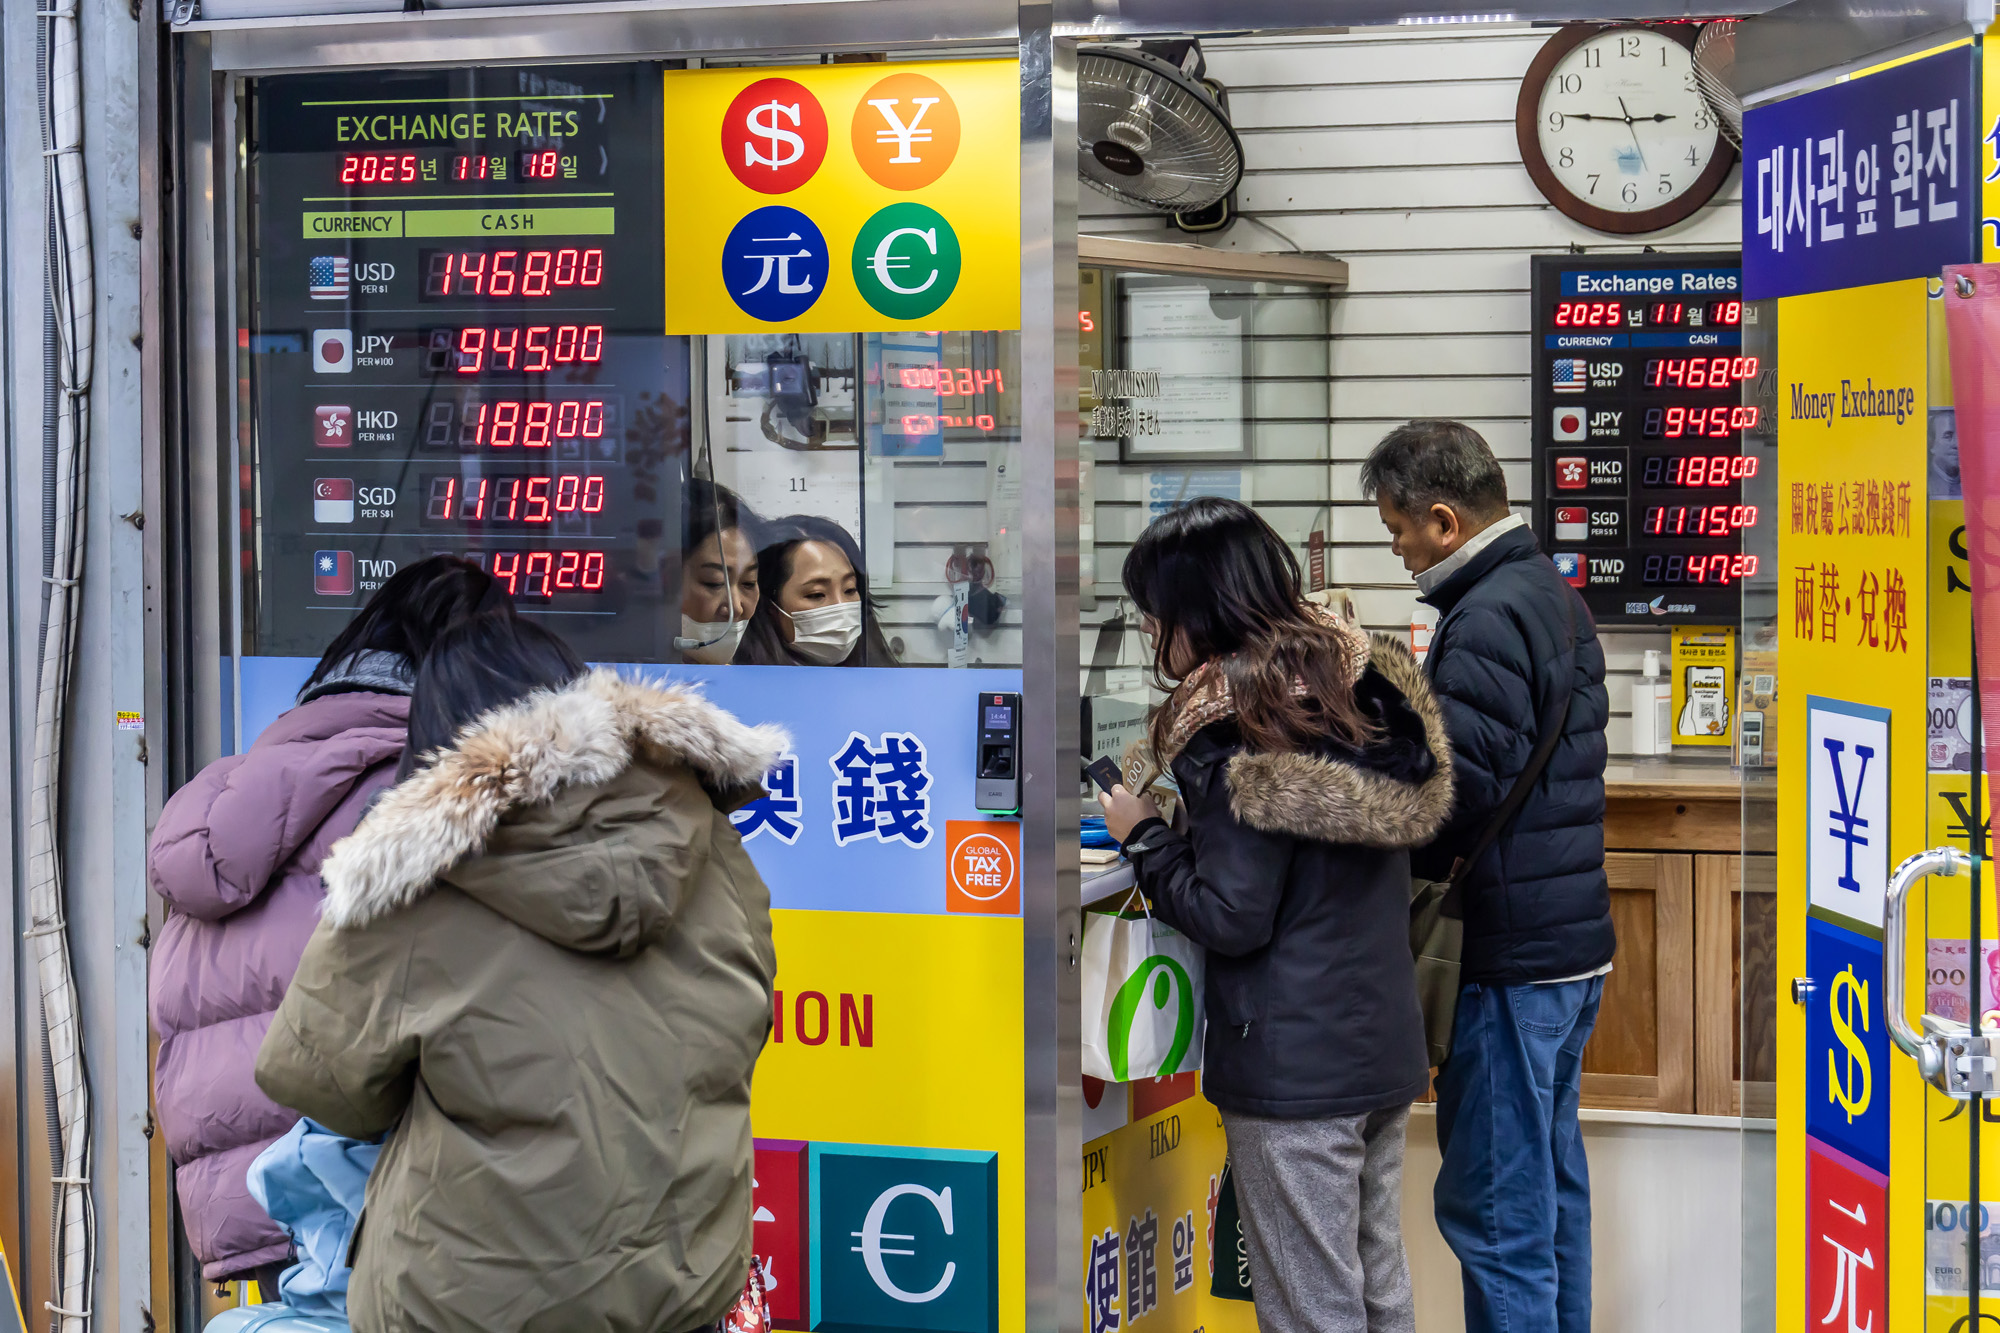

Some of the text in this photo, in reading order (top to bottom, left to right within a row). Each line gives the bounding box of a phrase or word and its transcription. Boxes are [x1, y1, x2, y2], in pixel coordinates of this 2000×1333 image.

[1584, 47, 1601, 68] 11
[1617, 36, 1641, 58] 12
[1658, 46, 1668, 67] 1
[1558, 74, 1582, 94] 10
[1684, 72, 1698, 93] 2
[336, 110, 579, 142] EXCHANGE RATES
[1549, 111, 1565, 133] 9
[1694, 109, 1709, 130] 3
[745, 97, 940, 171] $ ¥
[1559, 147, 1574, 168] 8
[1684, 145, 1700, 167] 4
[1586, 174, 1600, 195] 7
[1658, 174, 1672, 195] 5
[1757, 129, 1847, 253] 대사관
[1855, 144, 1880, 236] 앞
[1890, 98, 1958, 228] 환전
[1621, 182, 1637, 204] 6
[312, 214, 534, 233] CURRENCY CASH
[354, 249, 602, 296] USD 1468.00
[742, 227, 939, 296] 元 €
[361, 285, 377, 293] PER
[1577, 273, 1737, 294] Exchange Rates
[356, 325, 602, 372] JPY 945.00
[1557, 334, 1718, 347] CURRENCY CASH
[357, 357, 374, 366] PER
[1589, 363, 1623, 378] USD
[1655, 356, 1758, 388] 1468.00
[1091, 370, 1160, 399] NO COMMISSION
[1592, 379, 1606, 387] PER
[1790, 382, 1836, 428] Money
[1840, 378, 1914, 425] Exchange
[357, 401, 603, 447] HKD 188.00
[1590, 411, 1623, 427] JPY
[1665, 406, 1758, 438] 945.00
[1591, 428, 1605, 436] PER
[358, 432, 375, 441] PER
[1590, 456, 1758, 487] HKD 188.00
[789, 477, 808, 492] 11
[358, 476, 603, 522] SGD 1115.00
[361, 509, 377, 518] PER
[1591, 505, 1758, 536] SGD 1115.00
[358, 551, 603, 598] TWD 47.20
[1589, 552, 1758, 585] TWD 47.20
[1590, 575, 1604, 583] PER
[360, 581, 377, 590] PER
[1625, 602, 1649, 614] KEB
[1693, 680, 1720, 688] Check
[1127, 760, 1143, 786] 100
[1823, 737, 1875, 893] ¥
[965, 846, 1001, 855] GLOBAL
[964, 856, 1001, 873] TAX
[965, 874, 1001, 887] FREE
[1828, 963, 1872, 1124] $
[1150, 1115, 1181, 1160] HKD
[1082, 1146, 1109, 1192] JPY
[850, 1183, 956, 1303] €
[1821, 1198, 1874, 1333] 元
[1934, 1266, 1962, 1275] EURO
